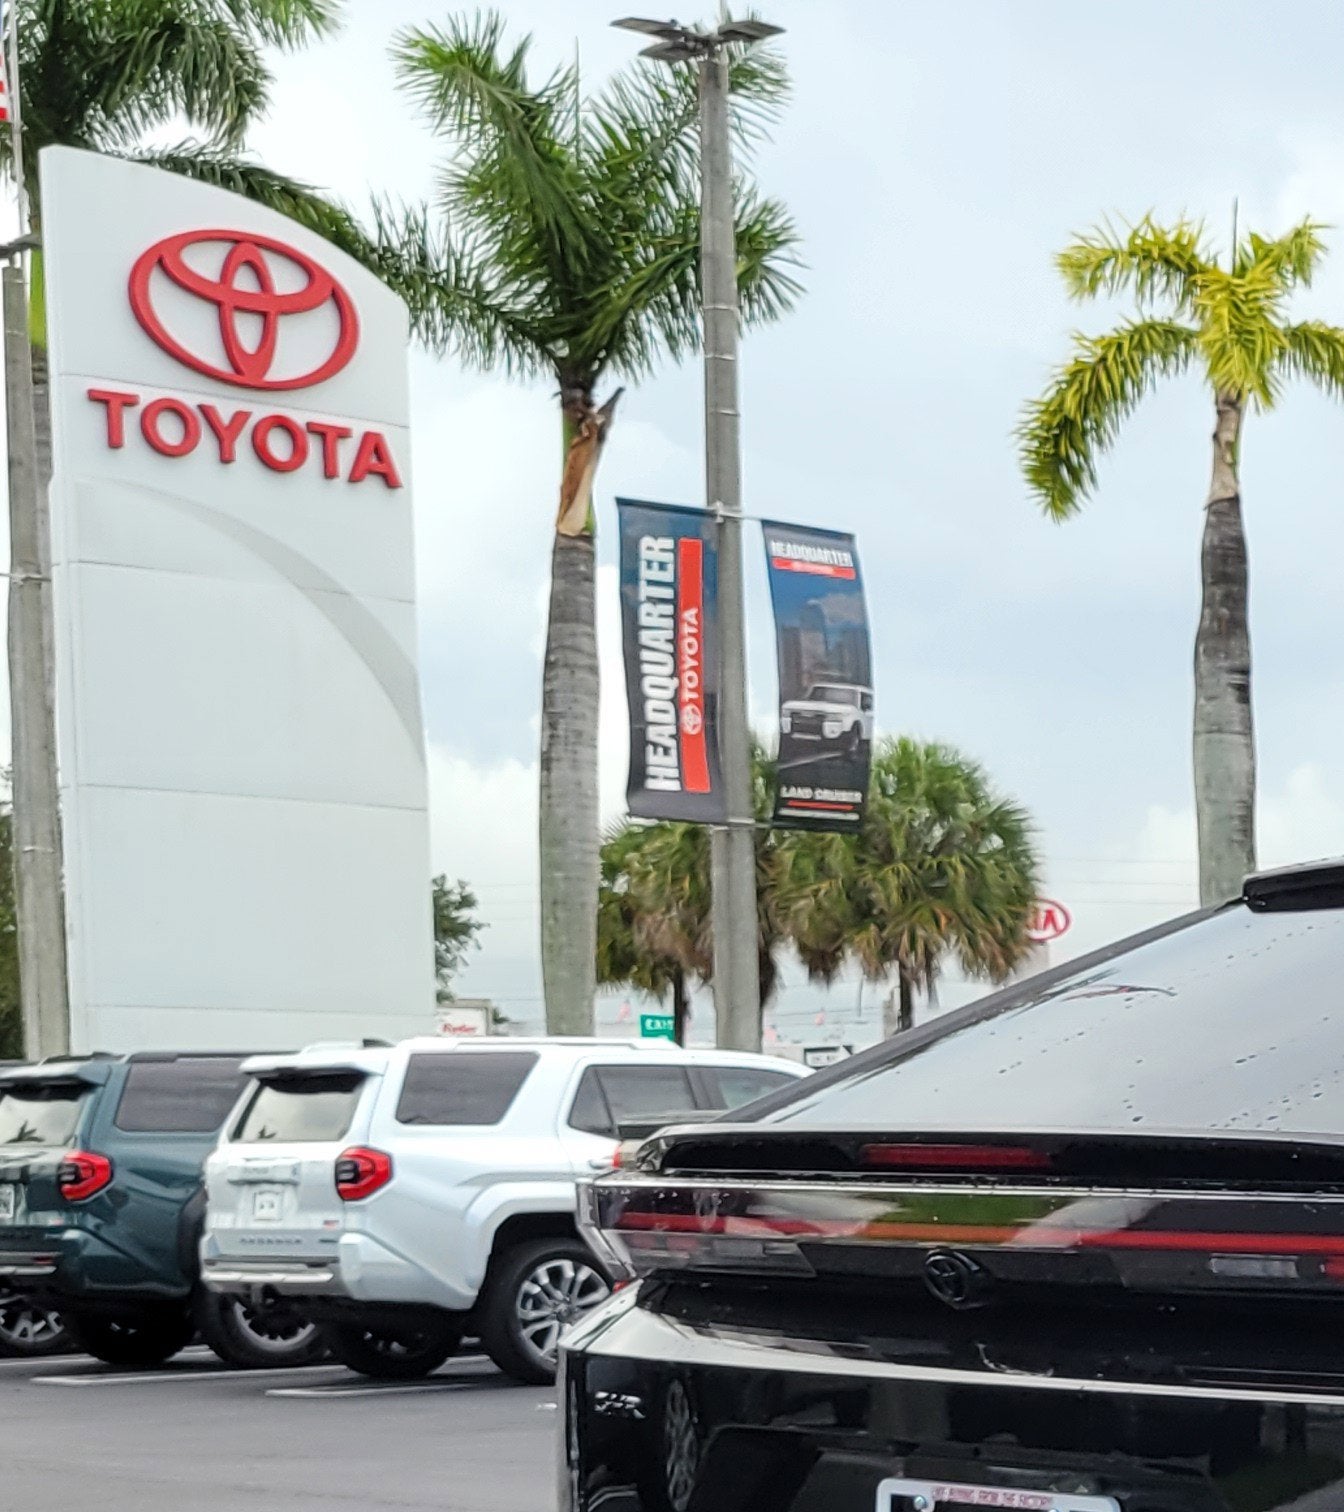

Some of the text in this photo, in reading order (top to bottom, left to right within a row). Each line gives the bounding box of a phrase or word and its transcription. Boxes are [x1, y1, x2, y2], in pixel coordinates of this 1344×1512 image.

[87, 388, 403, 488] TOYOTA
[638, 534, 682, 793] HEADQUARTER
[681, 607, 700, 703] TOYOTA
